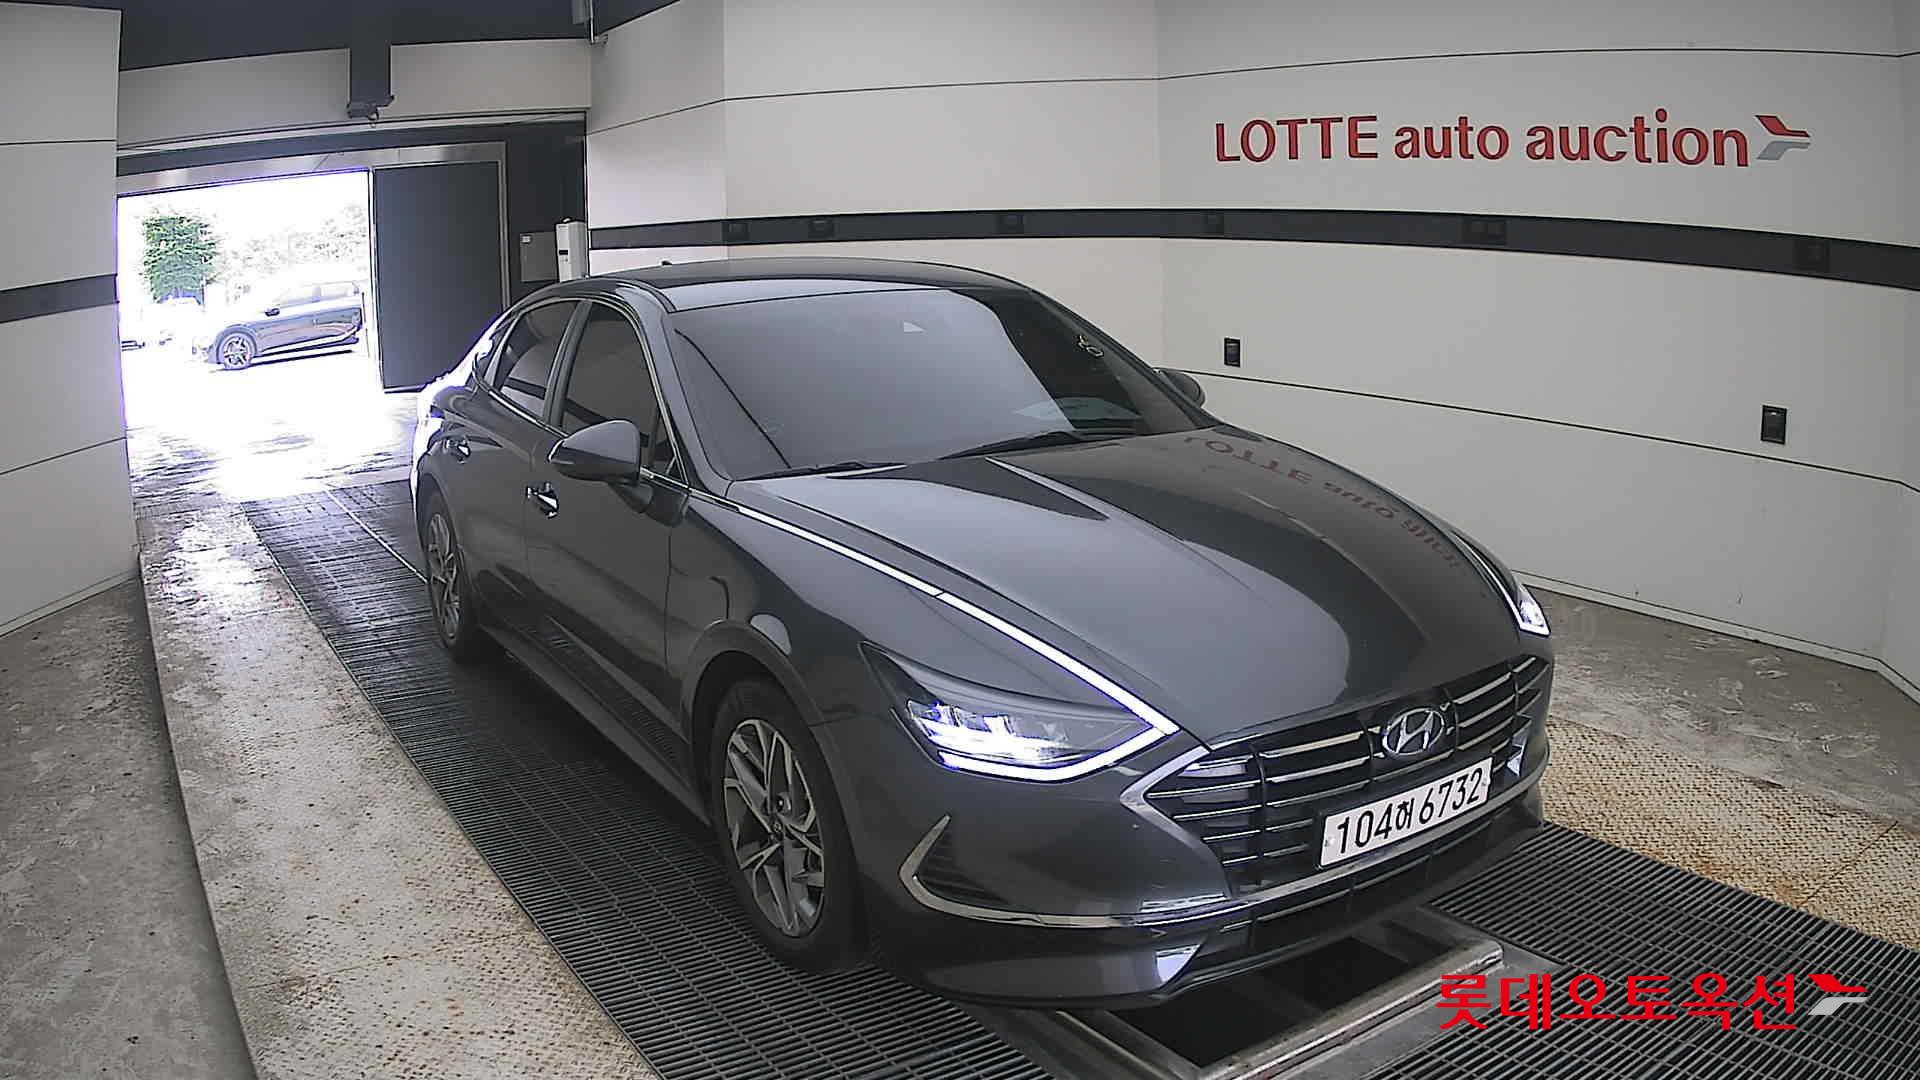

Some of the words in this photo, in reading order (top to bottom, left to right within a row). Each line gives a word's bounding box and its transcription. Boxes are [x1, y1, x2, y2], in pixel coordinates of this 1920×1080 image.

[1215, 115, 1378, 162] LOTTE
[1394, 116, 1510, 160] auto
[1526, 108, 1749, 167] auction
